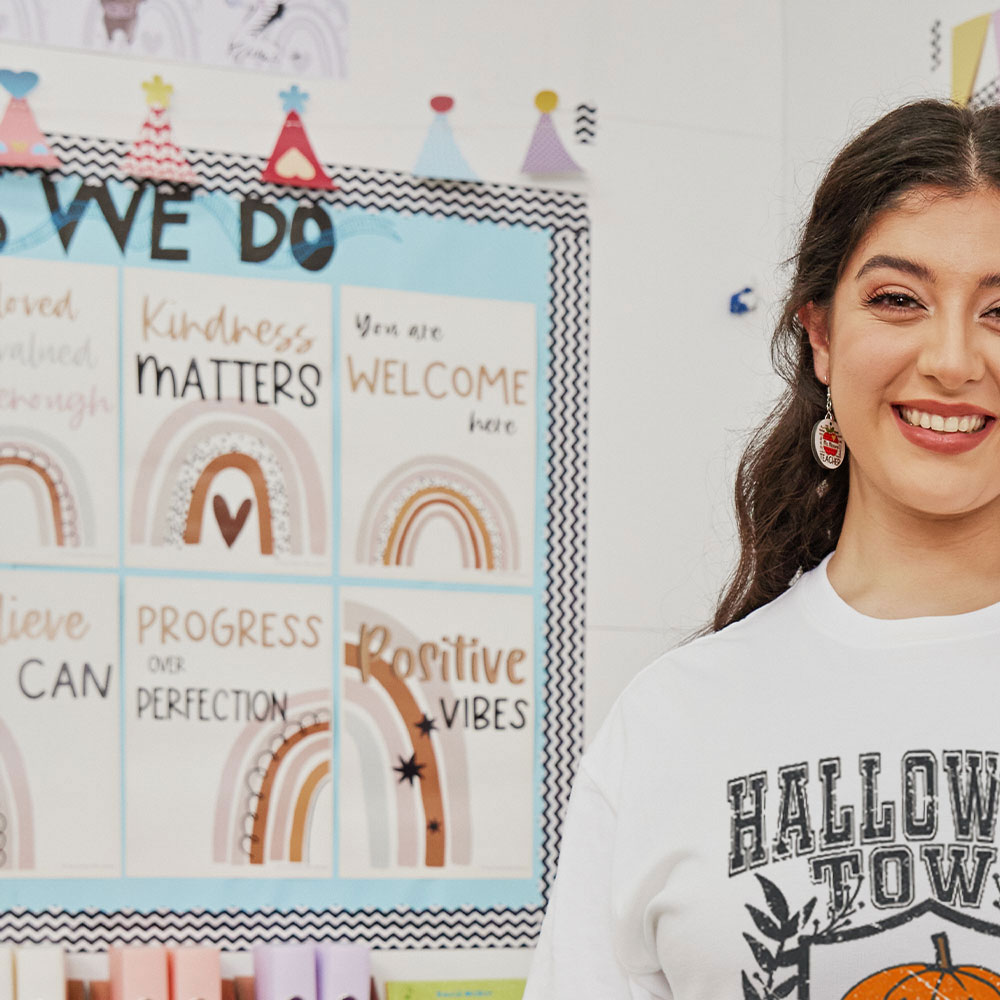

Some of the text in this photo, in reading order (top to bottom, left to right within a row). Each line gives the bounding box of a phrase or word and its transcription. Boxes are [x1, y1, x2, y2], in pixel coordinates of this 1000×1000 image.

[41, 176, 192, 262] WE
[240, 195, 336, 271] DO
[0, 288, 78, 321] oved
[142, 297, 316, 353] Kindness
[347, 356, 529, 406] WELCOME
[137, 605, 323, 648] PROGRESS
[150, 655, 184, 674] OVER
[358, 624, 526, 685] Positive
[18, 658, 112, 699] CAN
[136, 687, 288, 721] PERFECTION
[439, 696, 528, 730] VIBES
